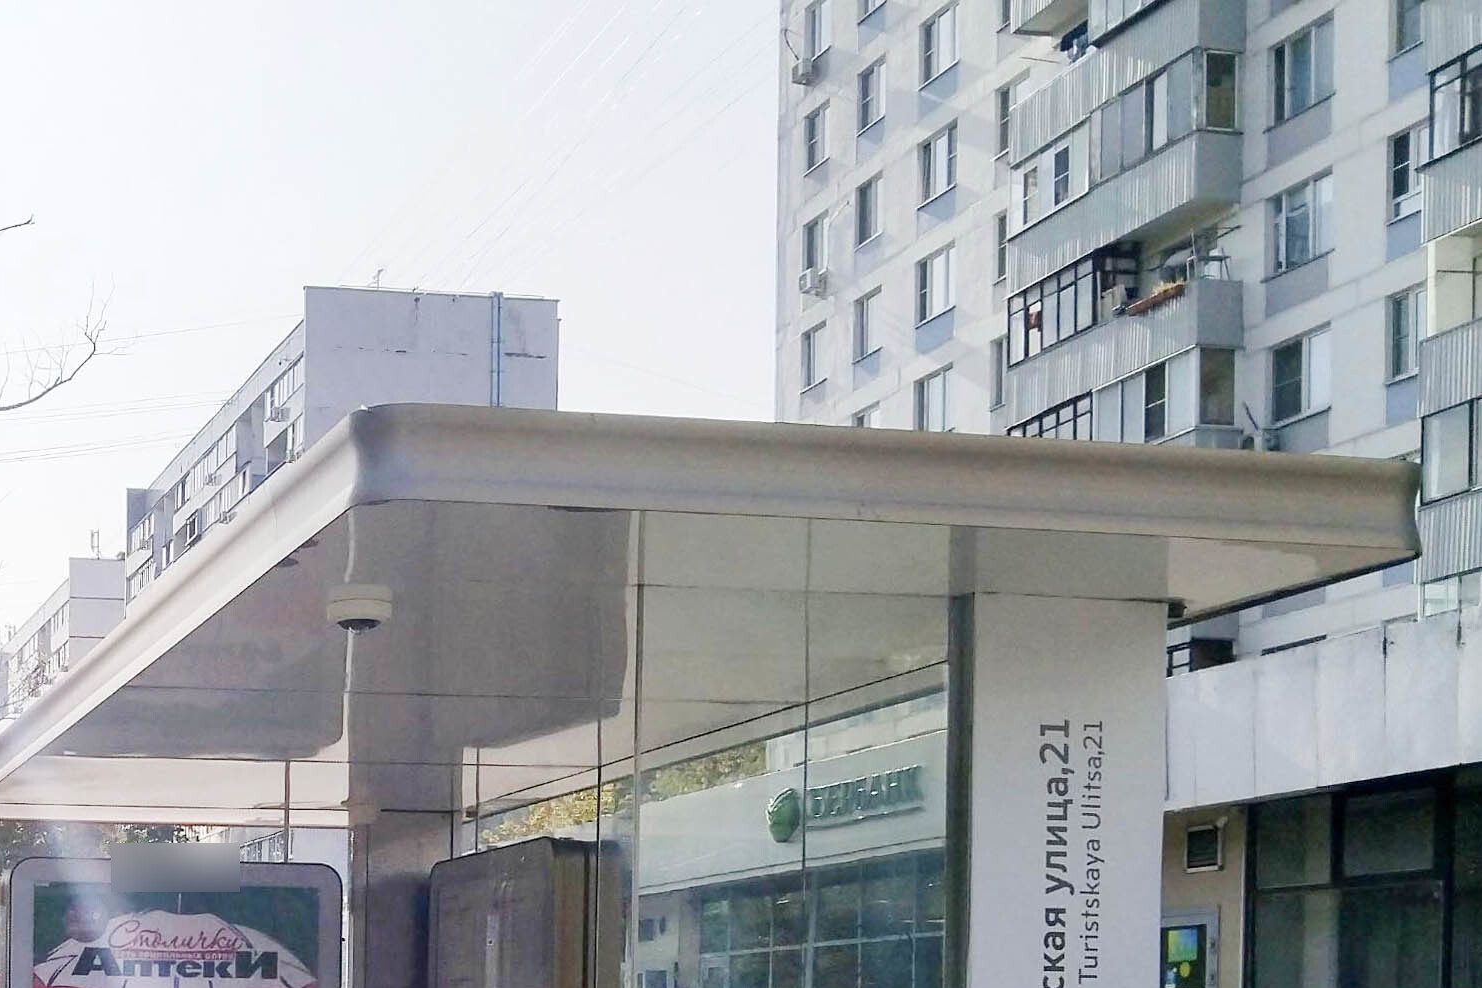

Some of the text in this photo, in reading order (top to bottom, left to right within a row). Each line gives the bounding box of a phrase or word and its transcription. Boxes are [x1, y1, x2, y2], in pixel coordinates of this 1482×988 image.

[1039, 719, 1075, 896] улица,21
[1078, 720, 1105, 985] Turistskaya Ulitsa,21
[109, 919, 243, 950] Столички
